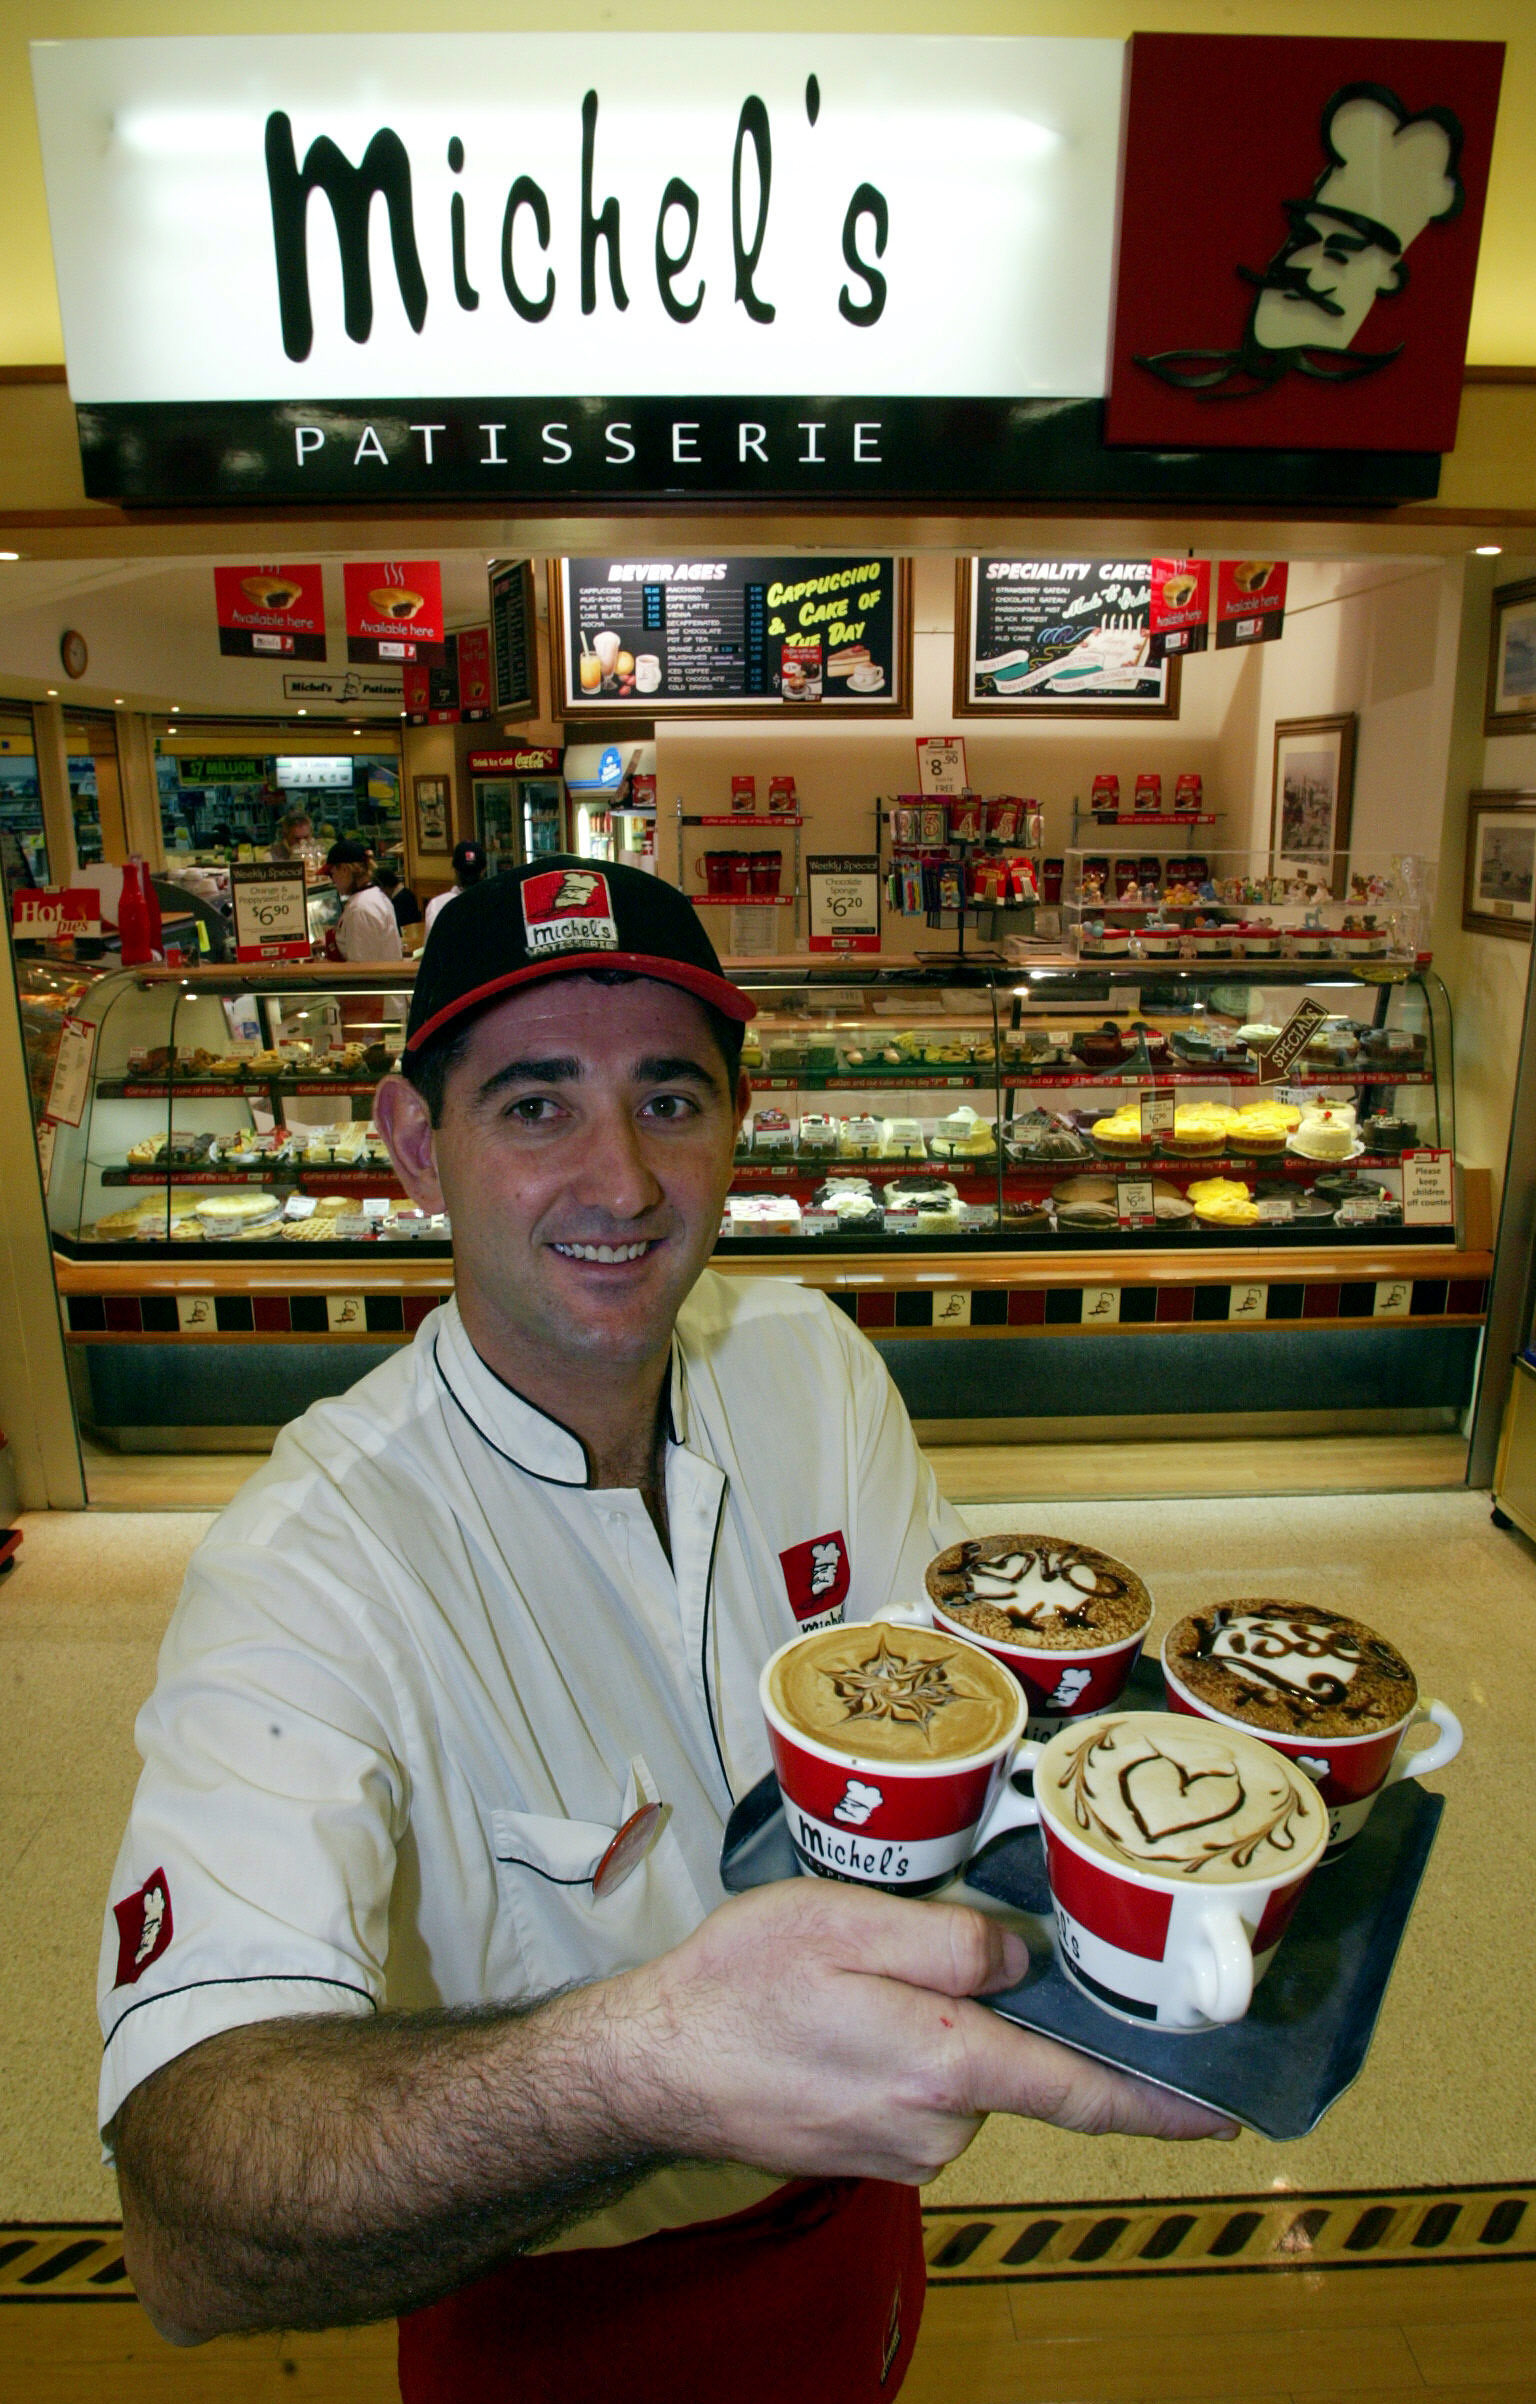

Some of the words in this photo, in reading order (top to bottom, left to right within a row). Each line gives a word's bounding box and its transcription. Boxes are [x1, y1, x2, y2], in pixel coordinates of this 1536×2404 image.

[264, 72, 890, 363] Michel's
[294, 421, 884, 467] PATISSERIE
[607, 563, 728, 582] BEVERAGES
[985, 563, 1092, 580] SPECIALITY
[232, 609, 284, 626] Available
[287, 613, 314, 629] here
[601, 612, 624, 620] BLACK
[995, 615, 1018, 623] BLACK
[1021, 615, 1048, 623] FOREST
[360, 619, 408, 635] Available
[410, 622, 435, 638] here
[828, 621, 866, 646] DAY
[290, 681, 333, 693] Michel's
[206, 760, 256, 775] MILLION
[472, 758, 488, 767] Drink
[499, 757, 513, 766] Cold
[959, 813, 977, 842] 4
[830, 886, 858, 895] Sponge
[20, 900, 64, 923] Hot
[56, 919, 89, 935] pies
[533, 919, 611, 945] Michel's
[1272, 1007, 1319, 1068] SPECIALS
[1415, 1166, 1441, 1175] Please
[1418, 1178, 1438, 1186] keep
[1412, 1188, 1445, 1196] children
[1407, 1199, 1419, 1207] off
[798, 1813, 911, 1877] Michel's
